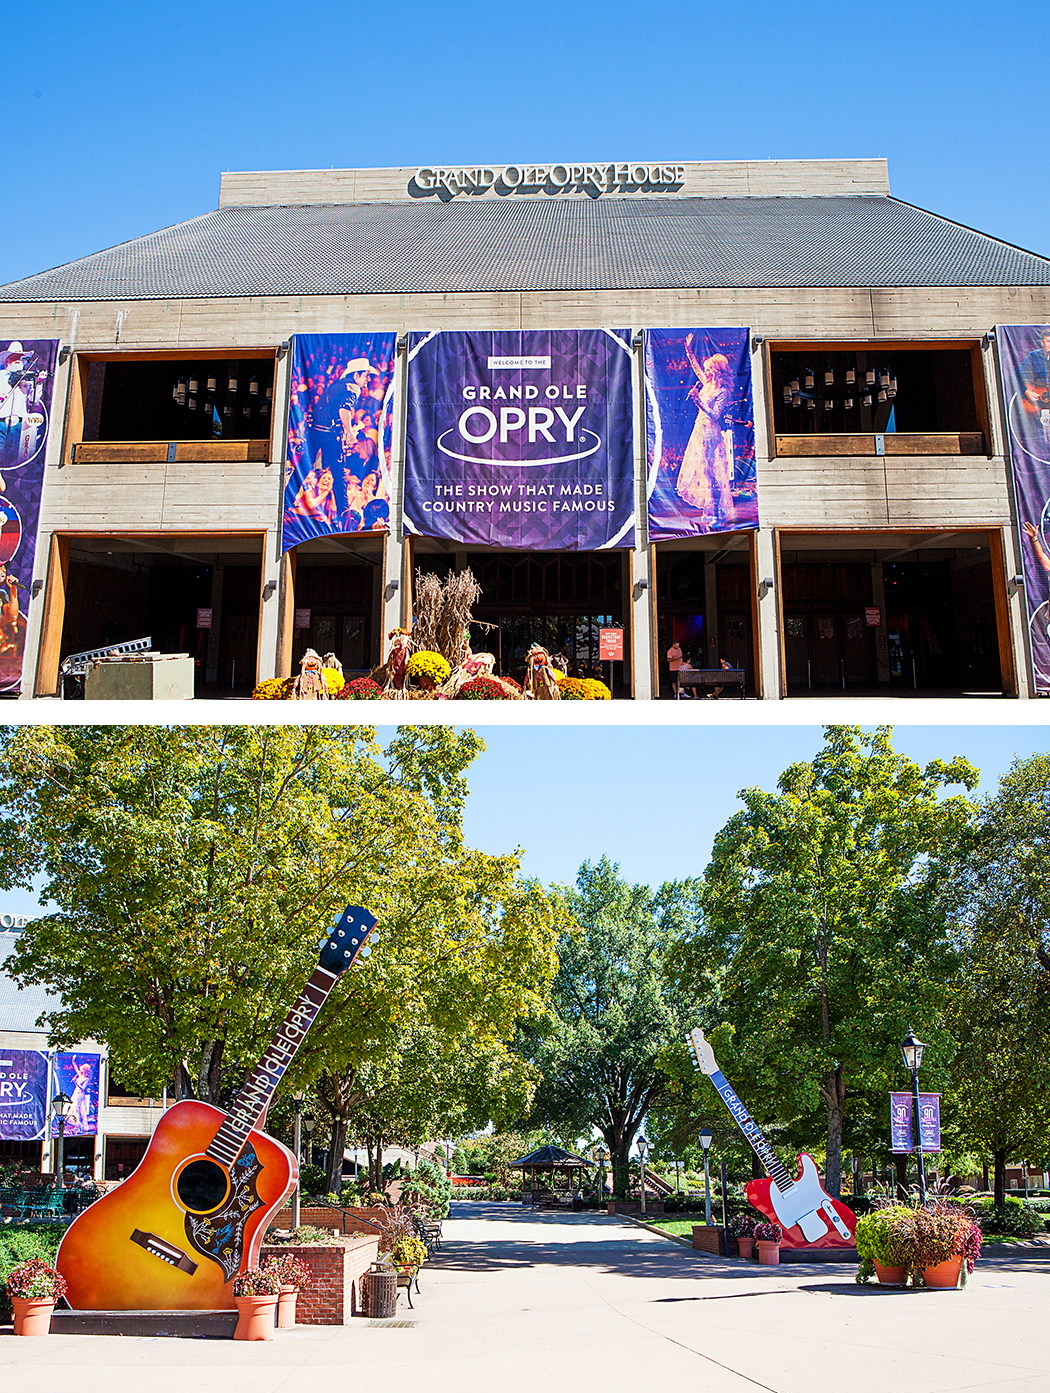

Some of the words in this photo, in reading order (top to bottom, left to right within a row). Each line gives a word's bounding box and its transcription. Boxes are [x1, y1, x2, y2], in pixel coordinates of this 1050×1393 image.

[415, 167, 496, 196] GRAND
[502, 166, 547, 188] OLE
[550, 163, 609, 192] OPRY
[613, 163, 686, 185] HOUSE
[462, 386, 539, 400] GRAND
[545, 384, 587, 399] OLE
[458, 406, 586, 444] OPRY
[435, 485, 462, 496] THE
[468, 485, 514, 496] SHOW
[518, 485, 555, 496] THAT
[560, 484, 603, 495] MADE
[422, 502, 494, 512] COUNTRY
[500, 502, 548, 512] MUSIC
[553, 500, 616, 512] FAMOUS
[286, 994, 312, 1038] OPRY
[266, 1038, 292, 1072] OLE
[0, 1082, 28, 1097] RY
[232, 1074, 270, 1132] GRAND
[724, 1089, 748, 1120] GRAND
[896, 1108, 906, 1118] 90
[924, 1108, 934, 1118] 90
